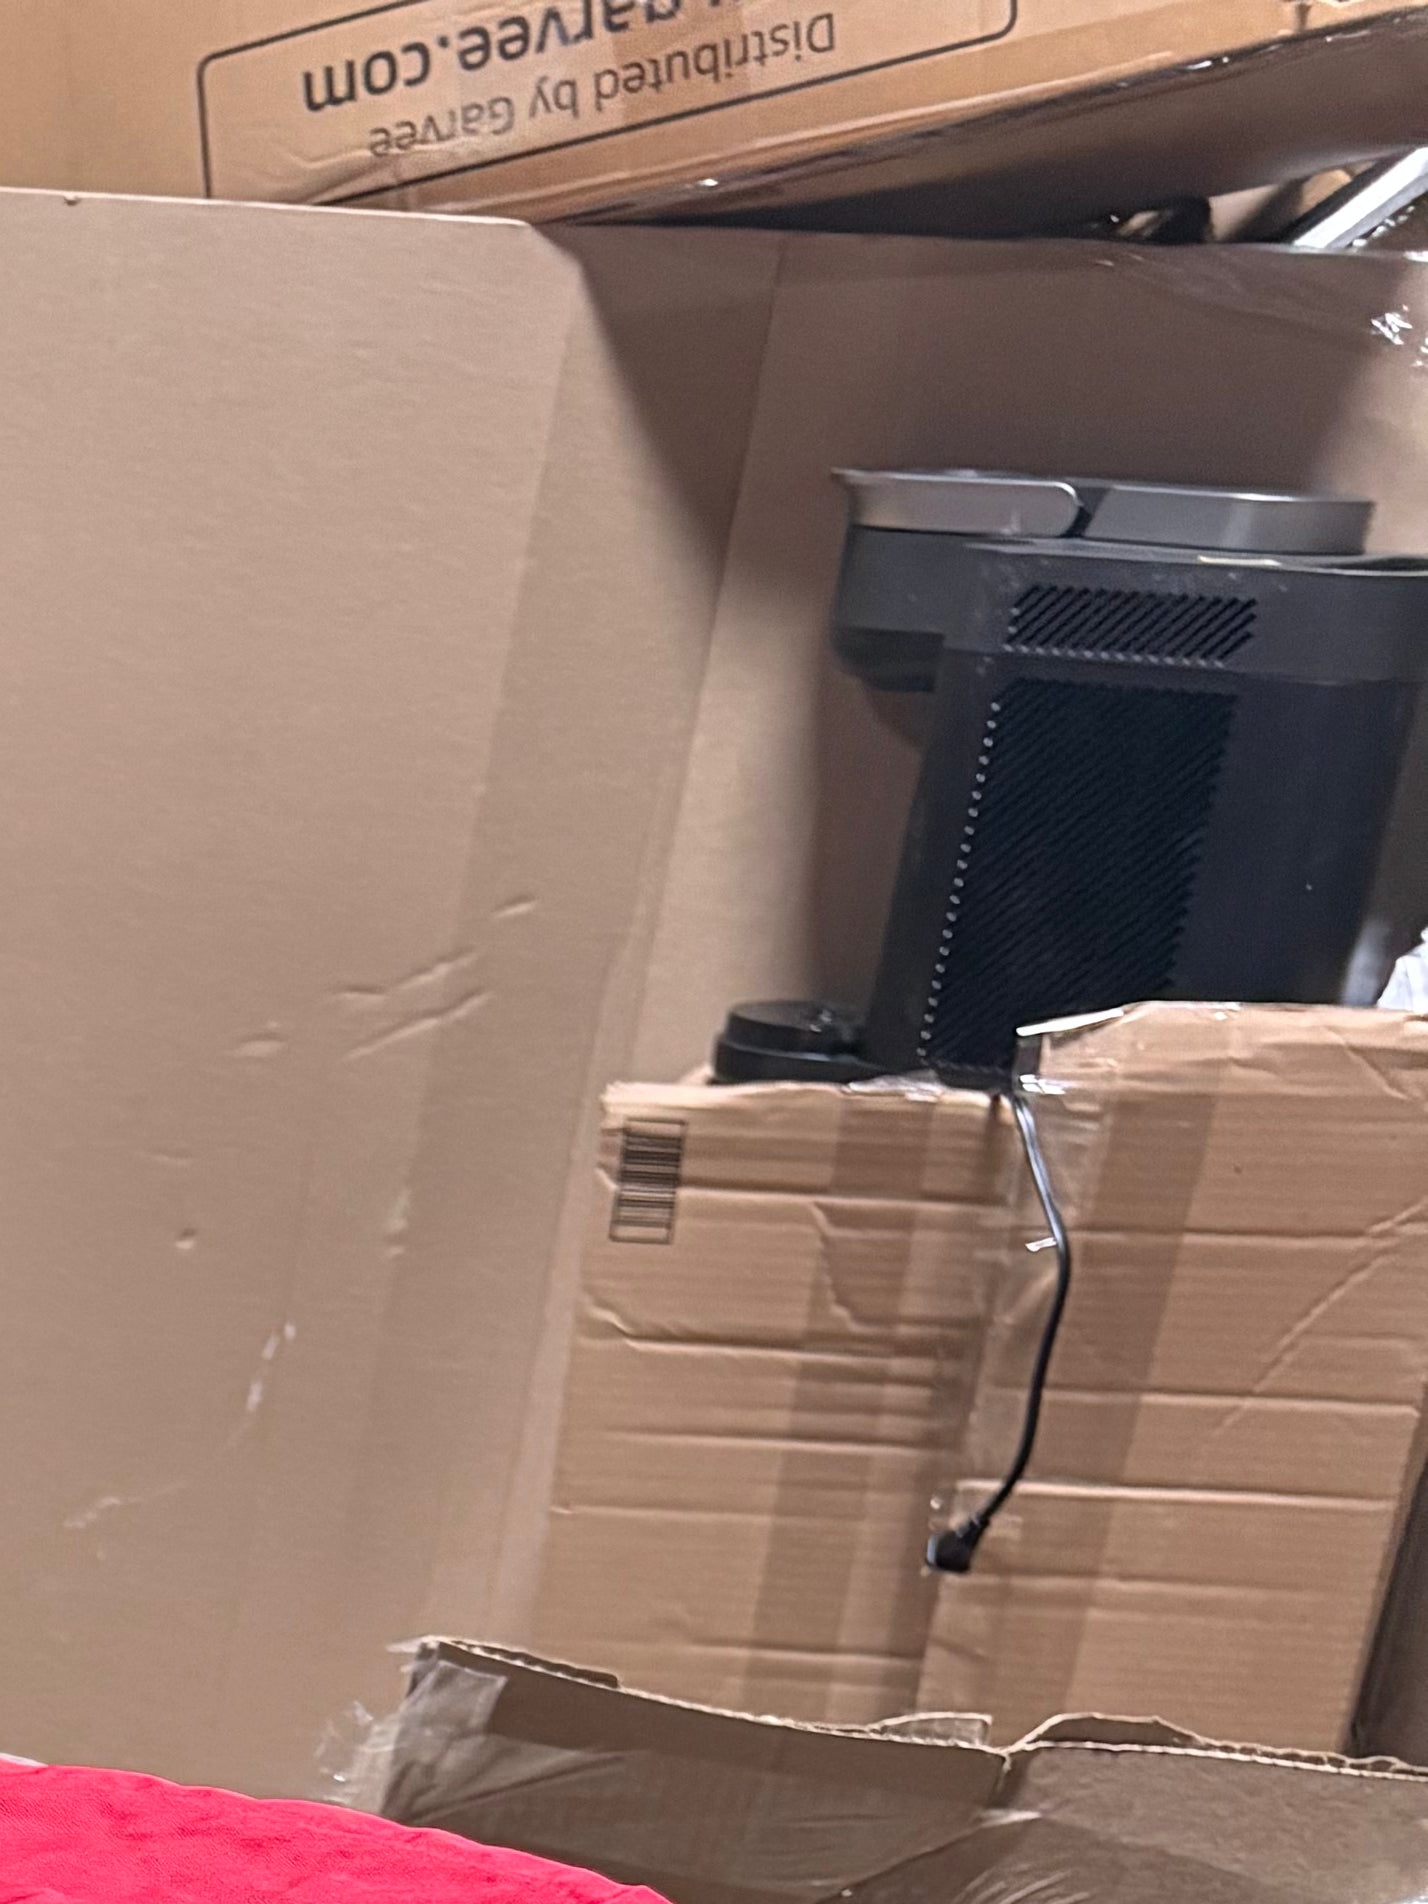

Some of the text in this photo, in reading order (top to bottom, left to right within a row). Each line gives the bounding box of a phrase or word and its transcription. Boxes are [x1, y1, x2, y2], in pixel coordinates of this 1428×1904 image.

[368, 12, 836, 158] Distributed by Garvee
